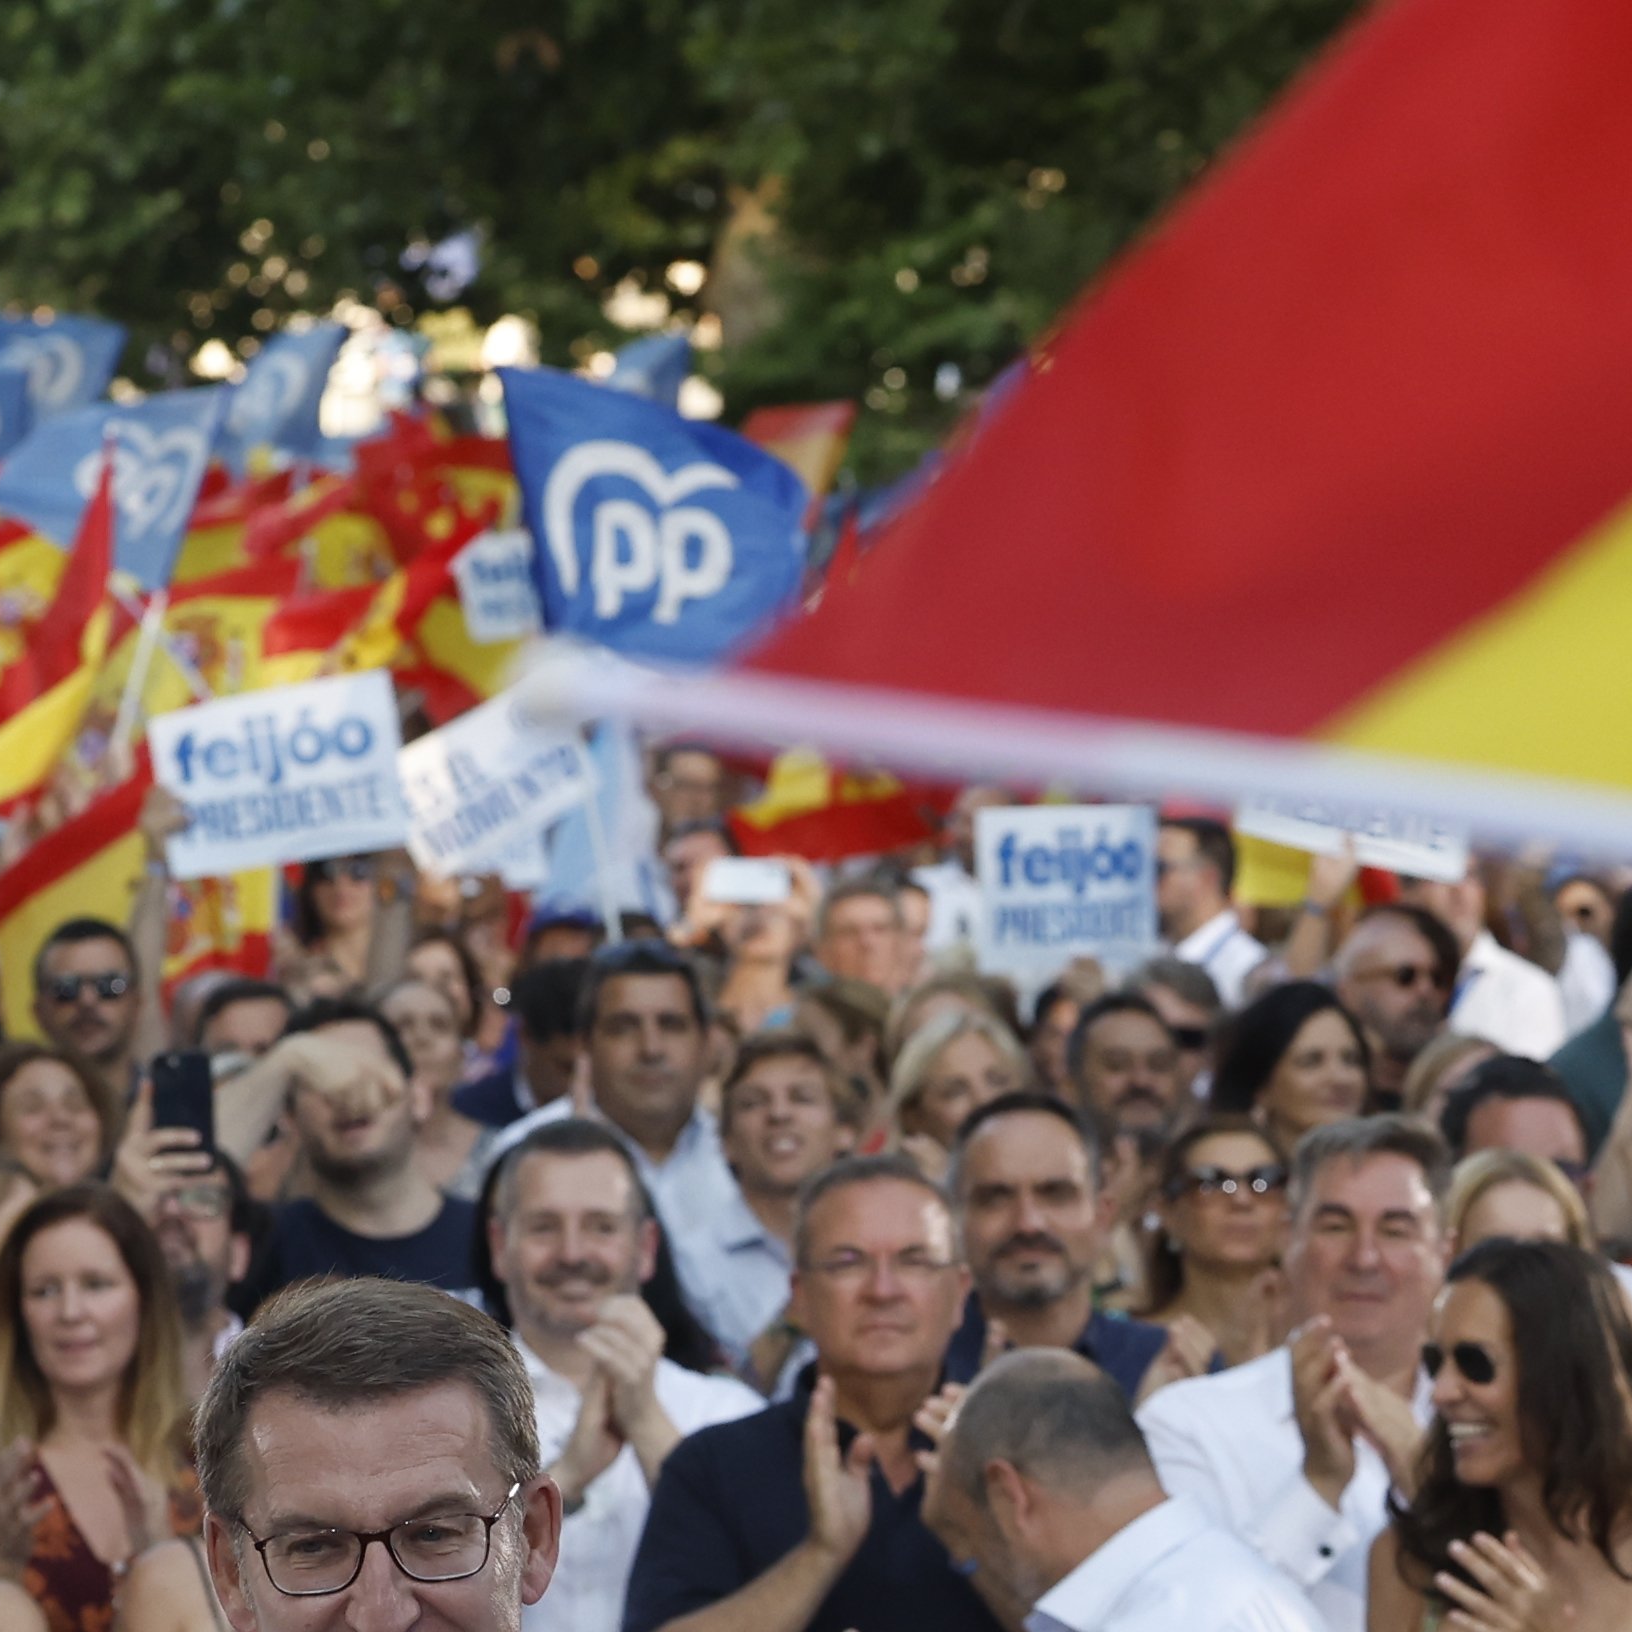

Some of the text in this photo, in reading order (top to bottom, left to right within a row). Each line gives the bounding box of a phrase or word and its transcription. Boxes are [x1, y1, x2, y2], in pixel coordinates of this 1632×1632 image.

[590, 499, 734, 626] pp
[177, 708, 373, 784] feijóo
[998, 823, 1143, 898] feijóo
